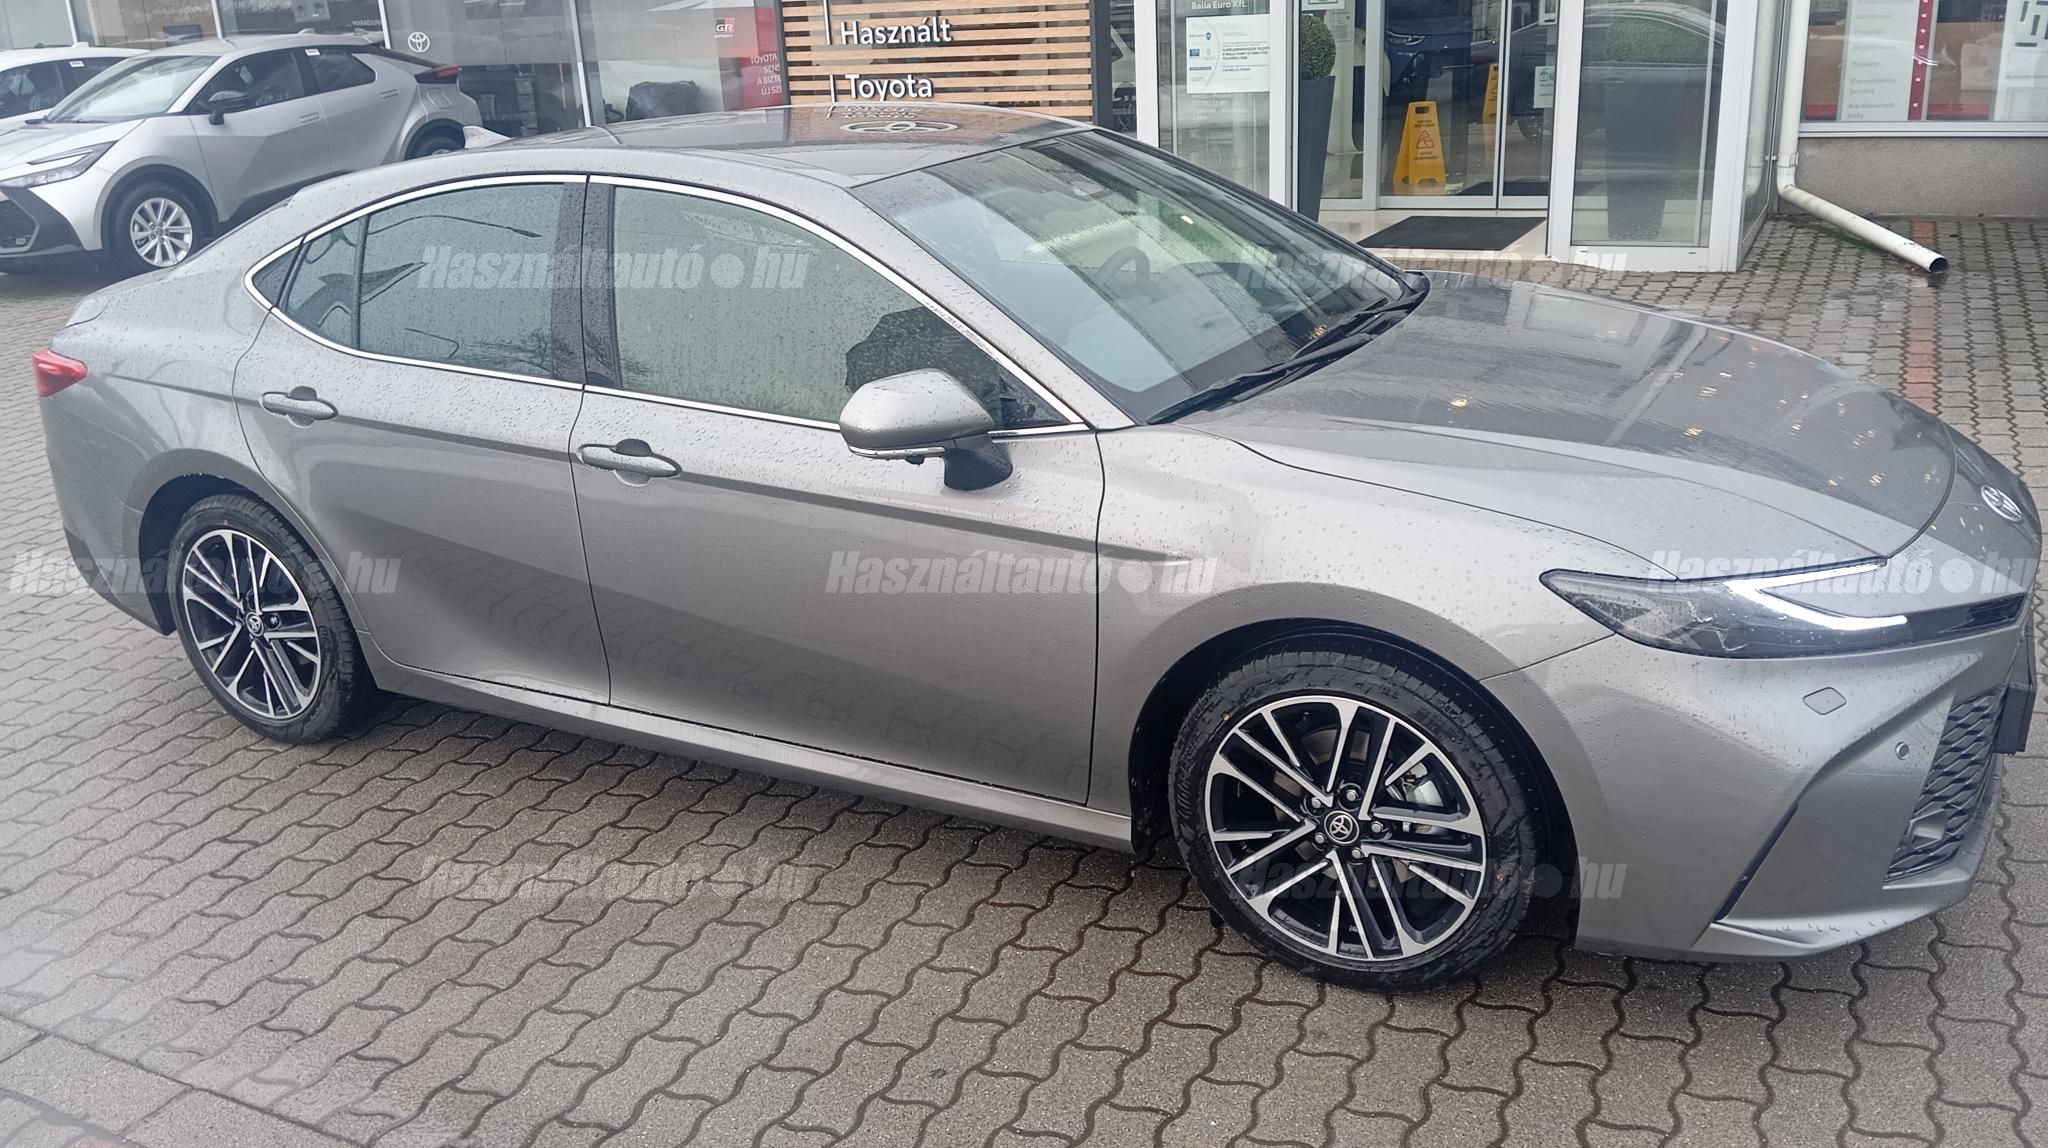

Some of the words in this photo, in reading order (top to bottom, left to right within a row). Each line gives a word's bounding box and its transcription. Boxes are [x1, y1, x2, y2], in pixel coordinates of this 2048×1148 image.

[1213, 0, 1231, 8] Euro
[716, 23, 734, 33] GR
[840, 17, 952, 45] Használt
[751, 53, 778, 64] TOYOTA
[845, 74, 934, 101] Toyota
